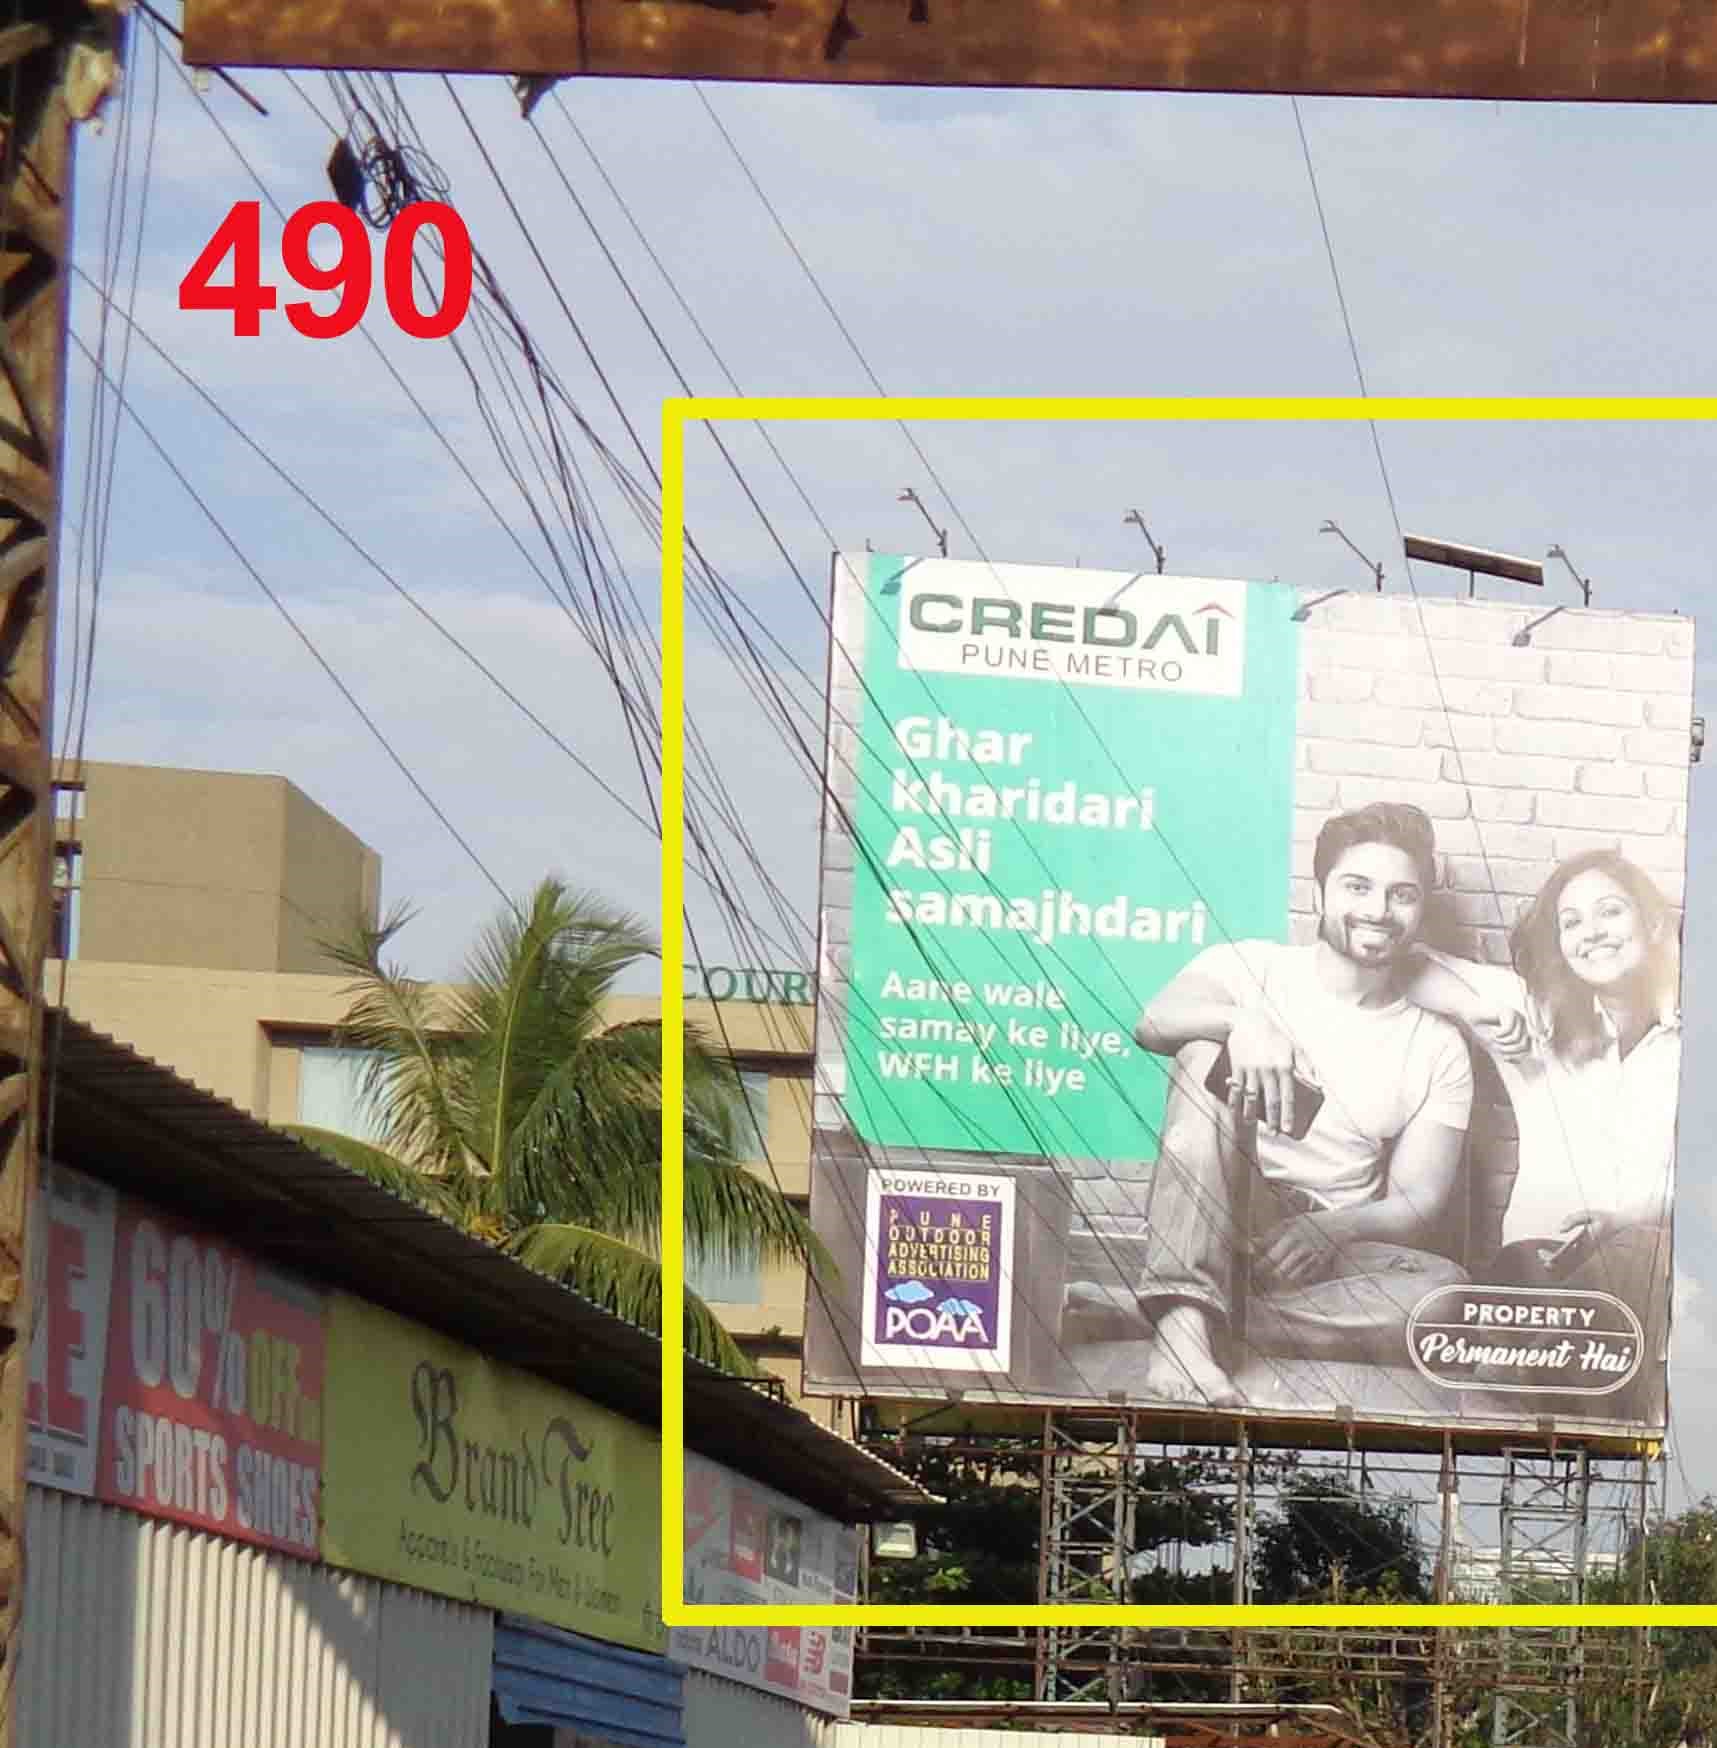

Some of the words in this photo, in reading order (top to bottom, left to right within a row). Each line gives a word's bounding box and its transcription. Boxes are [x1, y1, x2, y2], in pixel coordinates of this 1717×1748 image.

[909, 592, 1221, 656] CREDAI
[961, 643, 1050, 672] PUNE
[1066, 652, 1184, 682] METRO
[895, 715, 1033, 766] Ghar
[890, 768, 1157, 831] kharidari
[886, 826, 992, 873] Asli
[885, 884, 1207, 945] samajhdari
[879, 970, 972, 1003] Aane
[983, 980, 1066, 1011] wale
[878, 1015, 998, 1050] samay
[1006, 1018, 1049, 1049] ke
[1059, 1021, 1131, 1062] liye,
[878, 1050, 960, 1082] WFH
[970, 1054, 1013, 1089] ke
[1023, 1058, 1087, 1097] liye
[881, 1178, 971, 1196] POWERED
[976, 1183, 1001, 1198] BY
[888, 1208, 992, 1231] PUNE
[888, 1227, 991, 1247] OUTDOOR
[887, 1242, 990, 1263] ADVERTISING
[887, 1259, 989, 1281] ASSOCIATION
[130, 1217, 247, 1416] 60%
[885, 1306, 989, 1343] POAA
[1463, 1302, 1596, 1328] PROPERTY
[1419, 1332, 1576, 1369] Permanent
[1578, 1339, 1632, 1373] Hai
[112, 1405, 229, 1522] SPORTS
[235, 1439, 321, 1548] SHOES
[410, 1359, 537, 1529] Brand
[541, 1416, 615, 1557] Tree
[704, 1625, 761, 1673] ALDO
